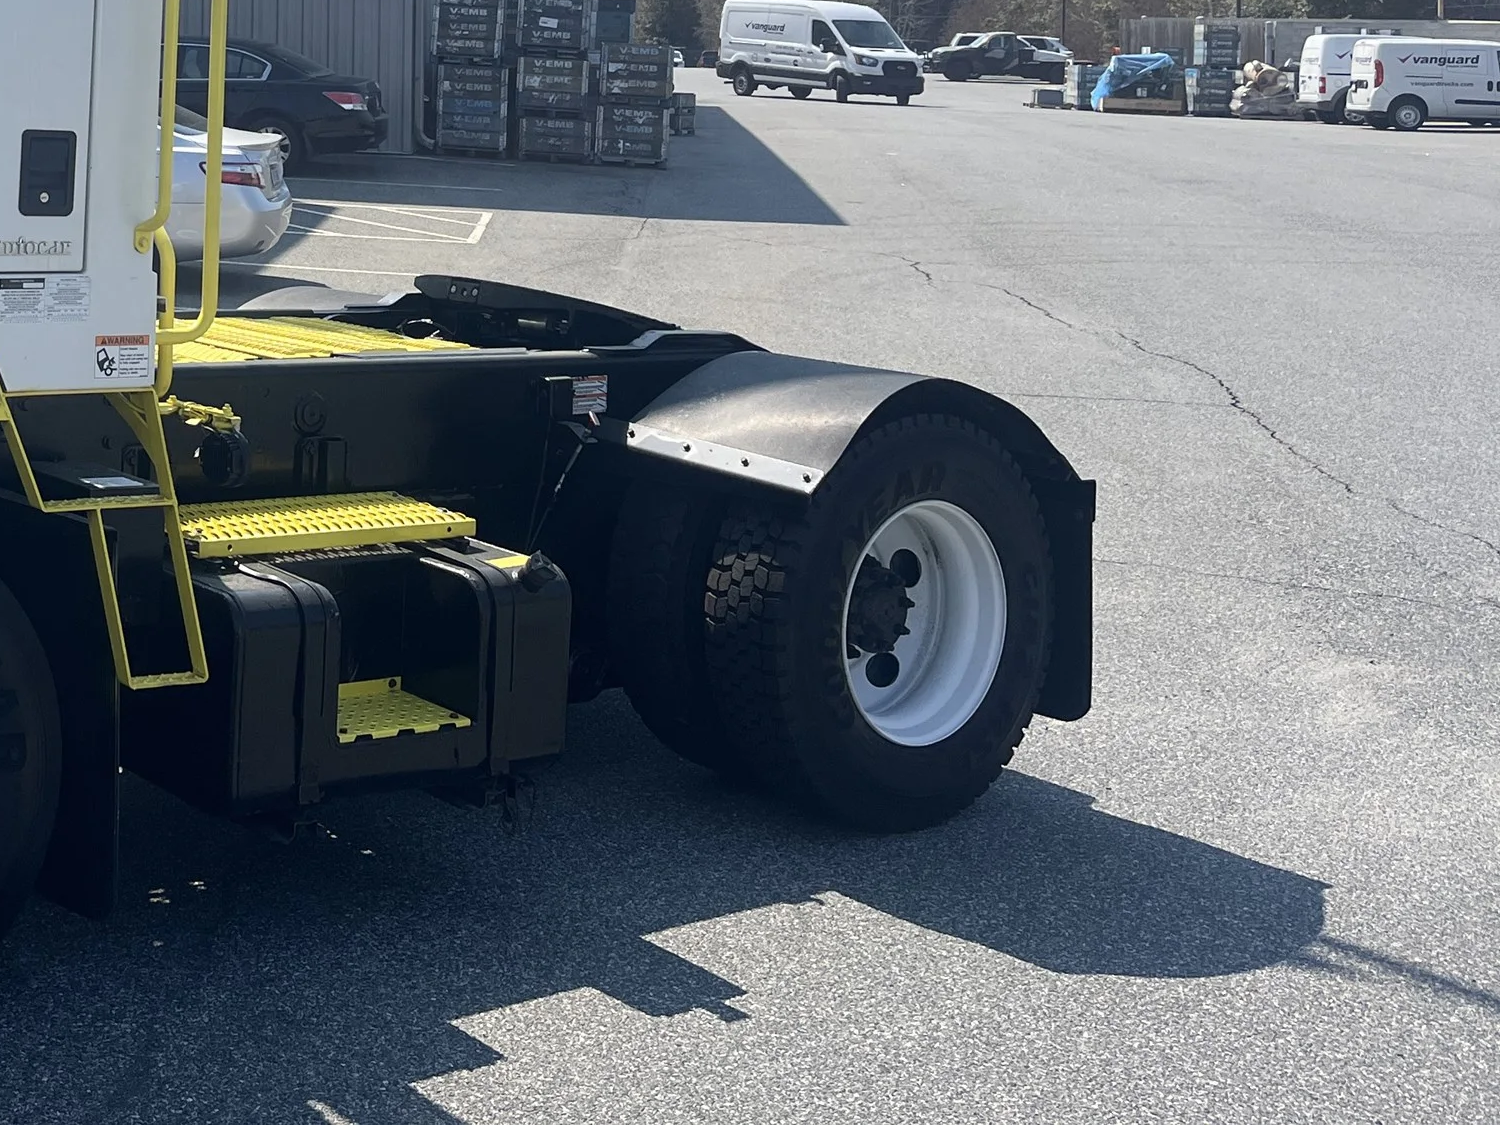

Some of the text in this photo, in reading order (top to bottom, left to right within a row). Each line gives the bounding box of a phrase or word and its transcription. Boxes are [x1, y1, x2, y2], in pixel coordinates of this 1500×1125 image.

[449, 7, 487, 16] V-EMB
[449, 23, 487, 31] V-EMB
[751, 23, 785, 33] vanguard
[532, 30, 571, 39] V-EMB
[620, 46, 659, 55] V-EMB
[534, 59, 573, 69] V-EMB
[1413, 55, 1480, 67] vanguard
[454, 67, 492, 76] V-EMB
[454, 82, 493, 91] V-EMB
[535, 119, 574, 128] V-EMB
[615, 125, 652, 134] V-EMB
[106, 336, 145, 345] WARNING
